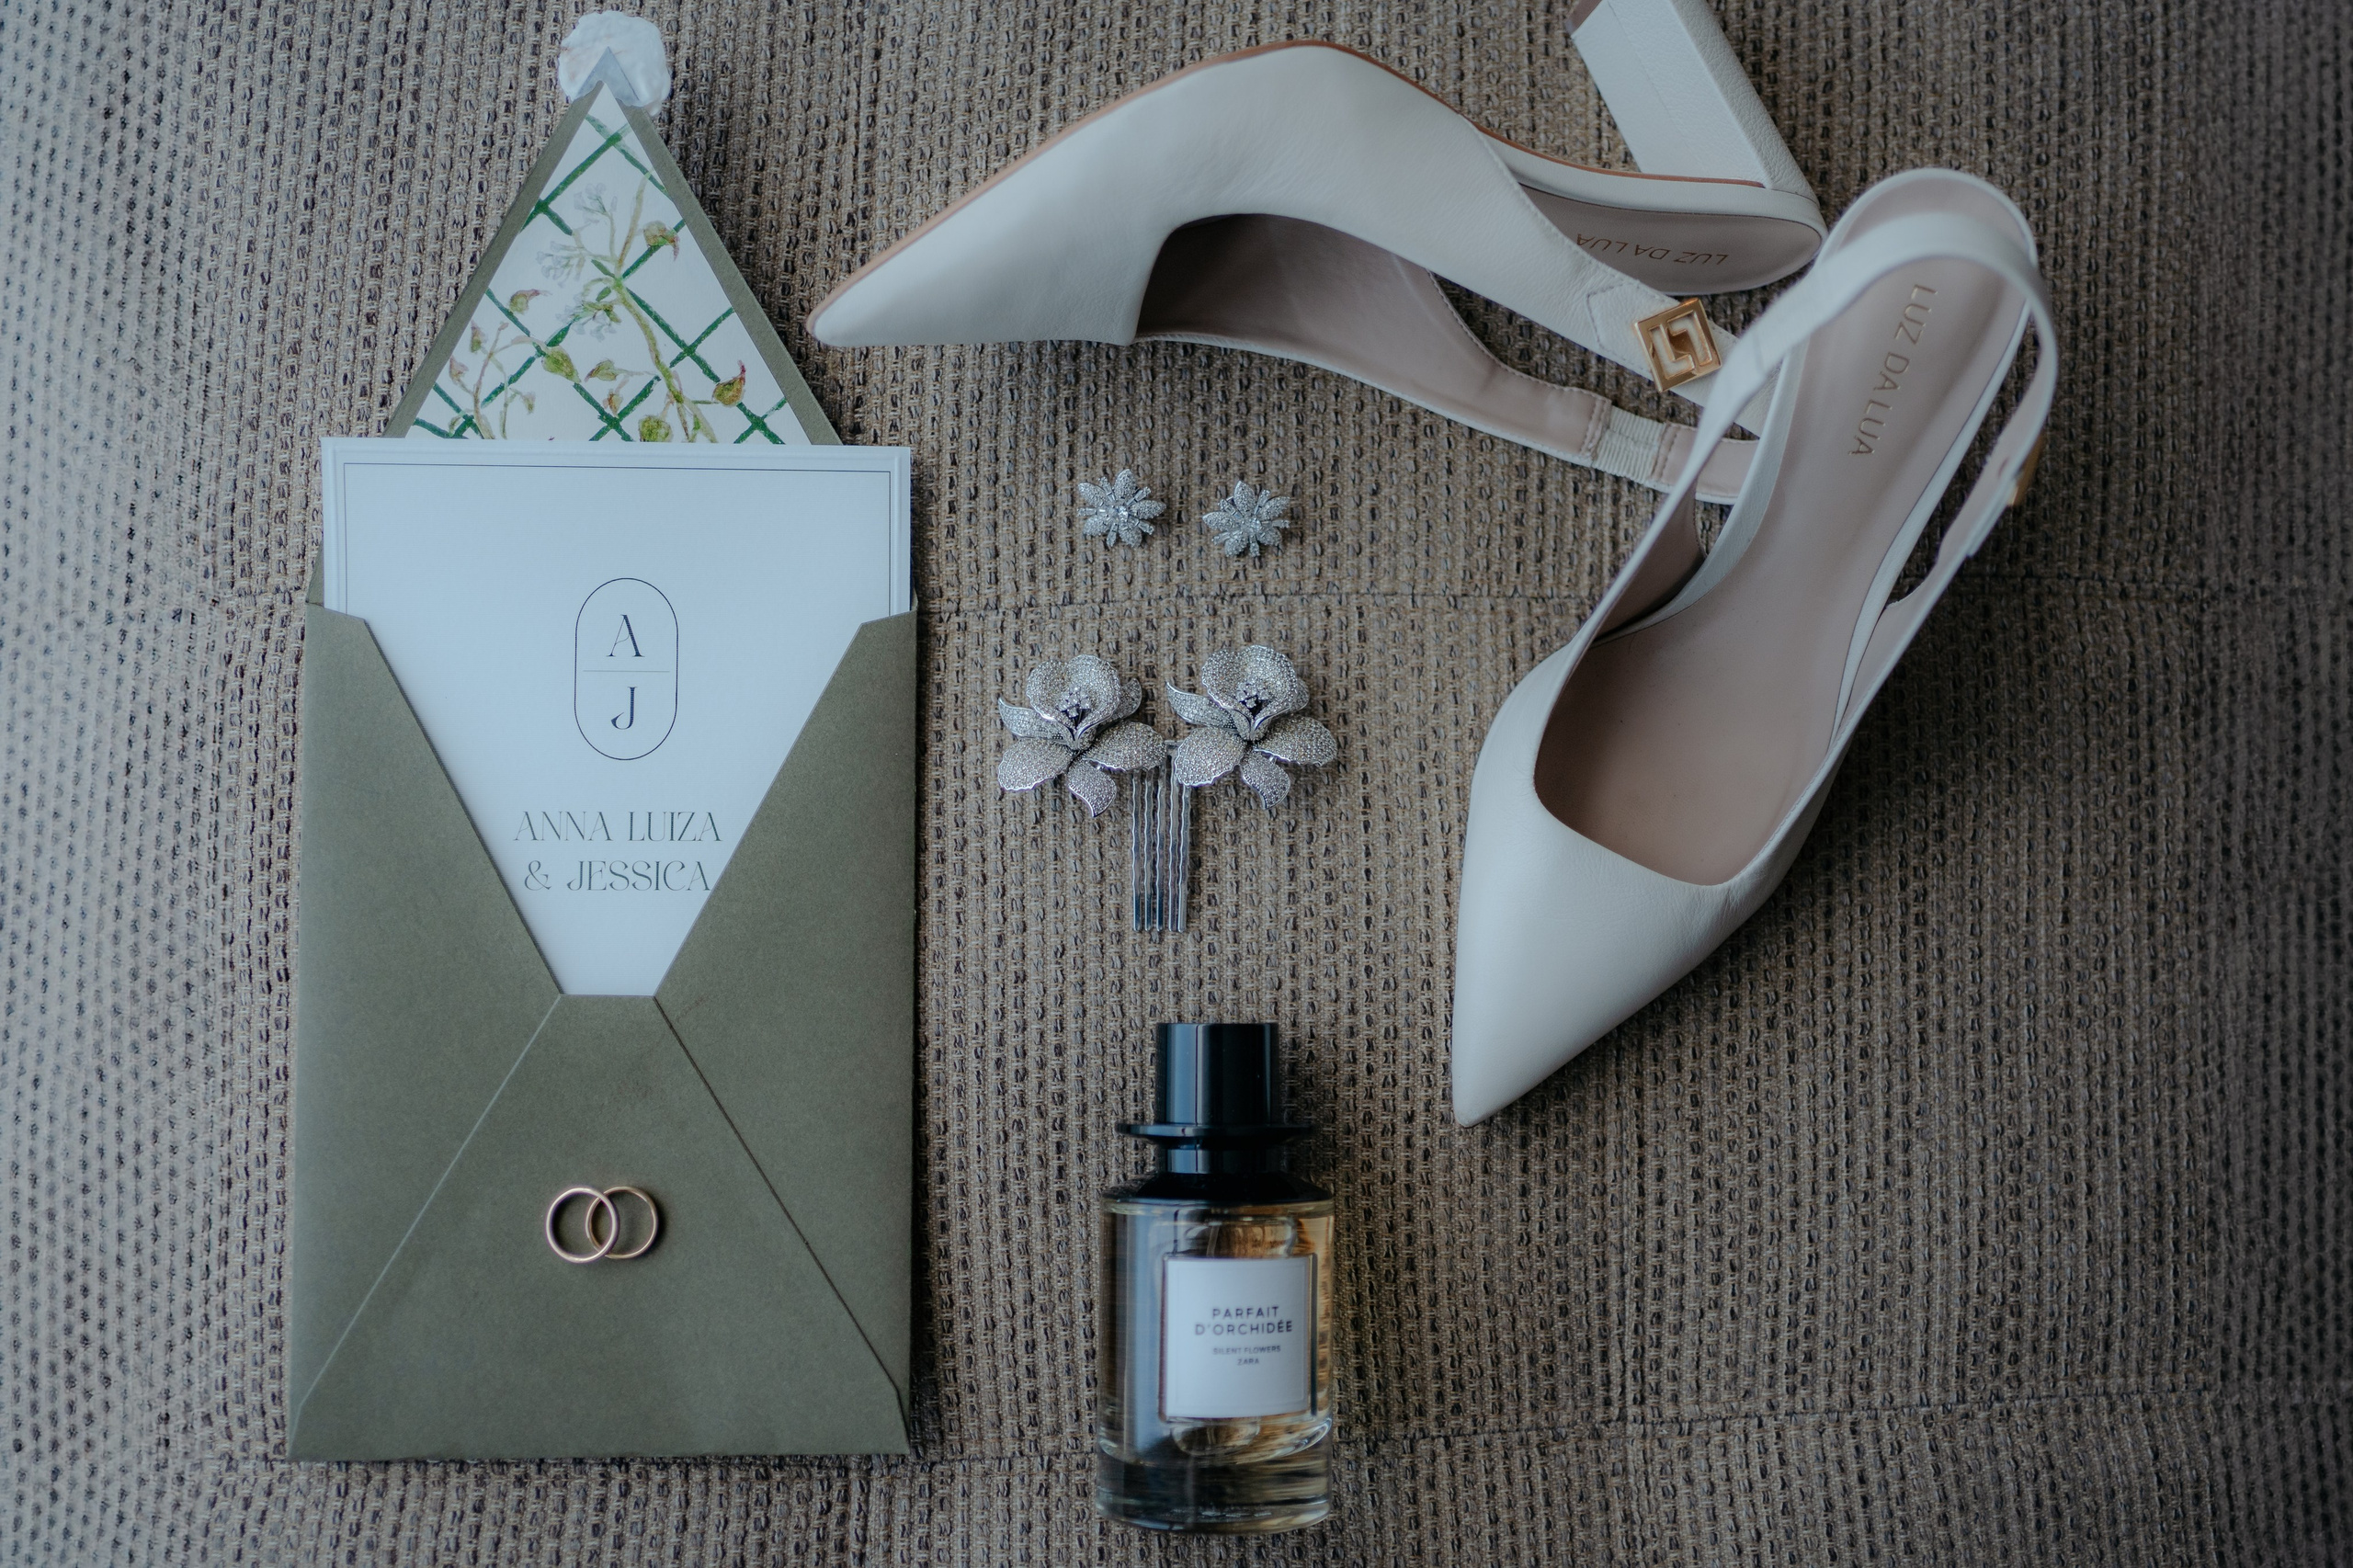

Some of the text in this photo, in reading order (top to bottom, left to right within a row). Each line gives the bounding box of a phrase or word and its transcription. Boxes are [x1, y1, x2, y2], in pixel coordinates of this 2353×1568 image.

[1576, 233, 1729, 265] LUZ DA LUA
[1848, 283, 1938, 455] LUZ DA LUA
[606, 614, 645, 658] A
[610, 686, 638, 731] J
[513, 811, 723, 842] ANNA LUIZA
[524, 859, 711, 892] & JESSICA
[1195, 1320, 1293, 1335] D'ORCHIDÉE
[1212, 1306, 1279, 1320] PARFAIT
[1212, 1345, 1281, 1356] SILENT FLOWERS
[1237, 1358, 1260, 1367] ZARA
